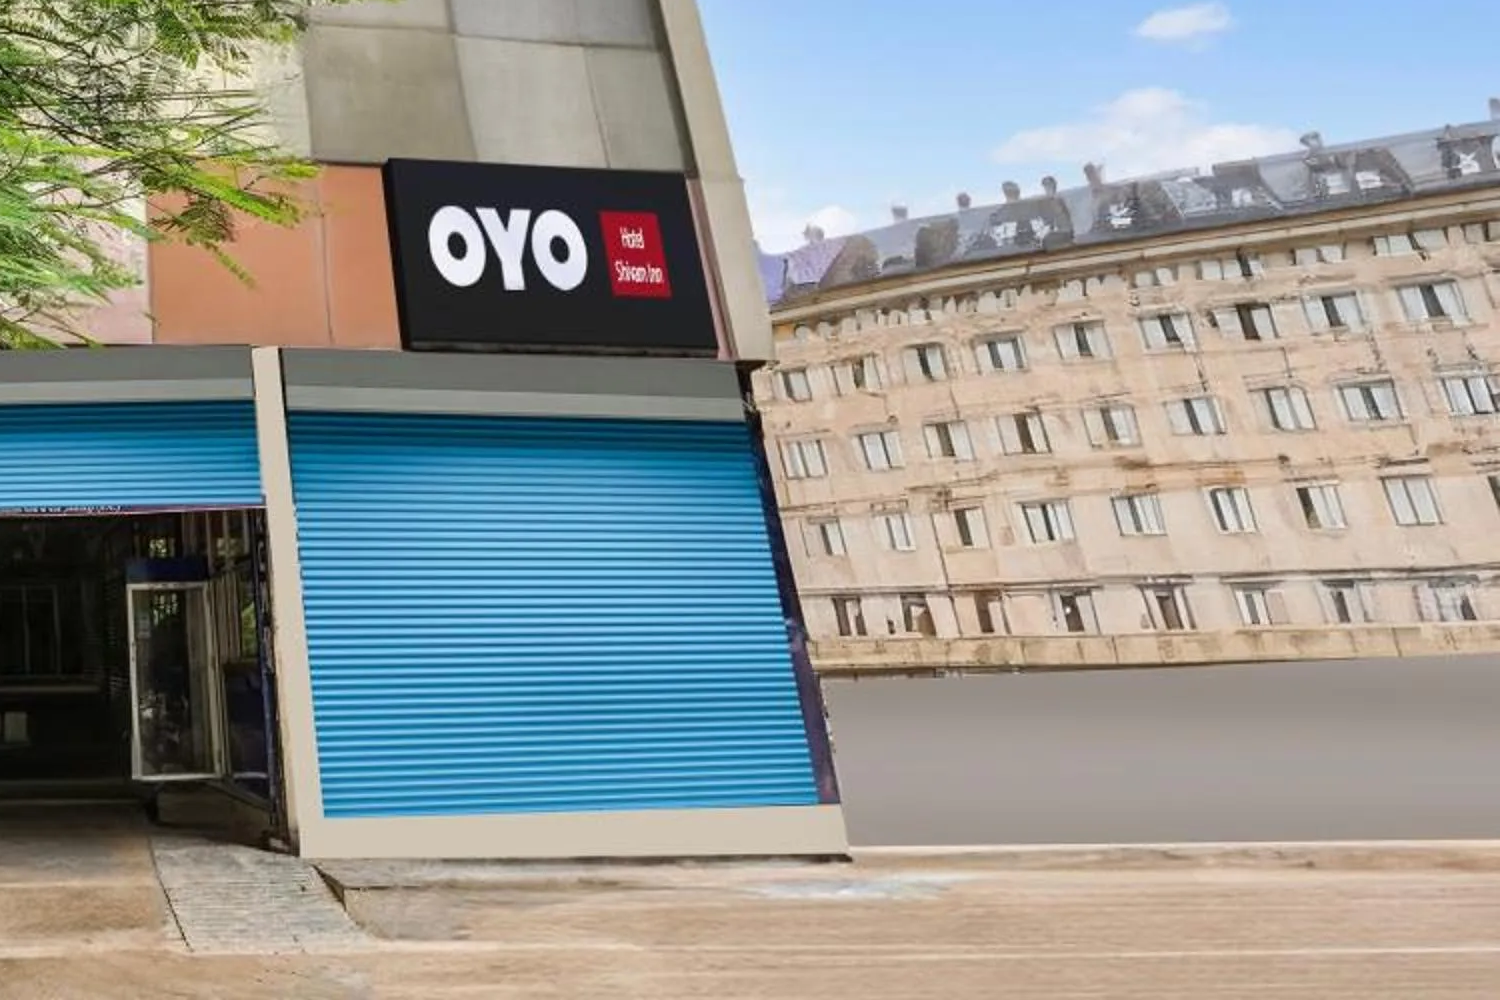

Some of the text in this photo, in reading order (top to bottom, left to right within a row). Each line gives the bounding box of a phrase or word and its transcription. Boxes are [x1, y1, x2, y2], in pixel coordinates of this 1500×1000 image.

[428, 205, 588, 291] OYO
[619, 226, 645, 249] Hotel
[614, 259, 664, 284] Shivam Inn
